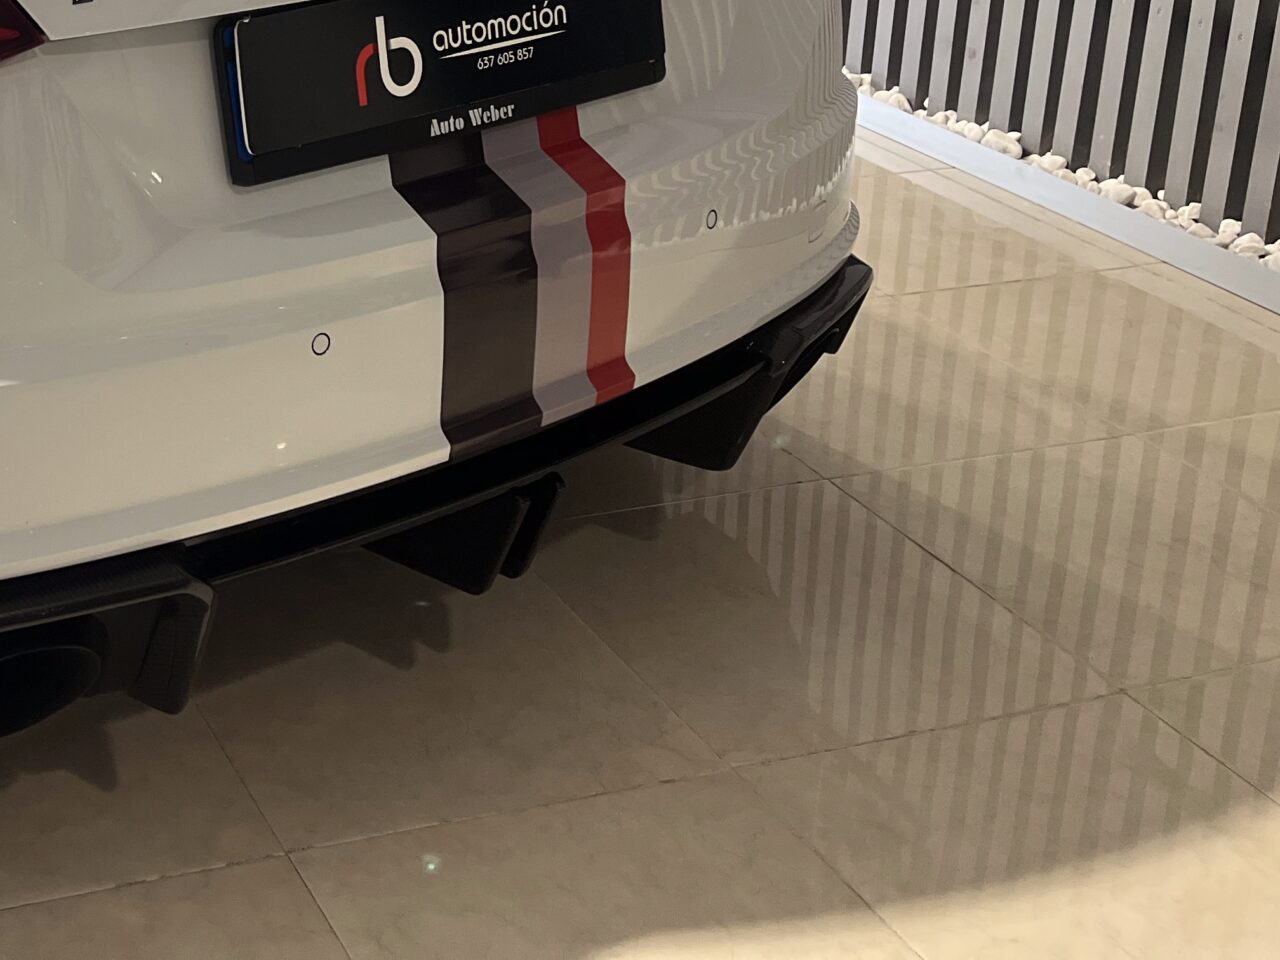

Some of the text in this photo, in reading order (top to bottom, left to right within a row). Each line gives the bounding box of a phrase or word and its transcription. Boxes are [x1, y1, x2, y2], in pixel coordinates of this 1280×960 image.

[432, 0, 568, 52] automoción
[355, 15, 423, 107] rb
[476, 46, 534, 70] 637 605 857
[430, 103, 515, 137] Auto Weber
